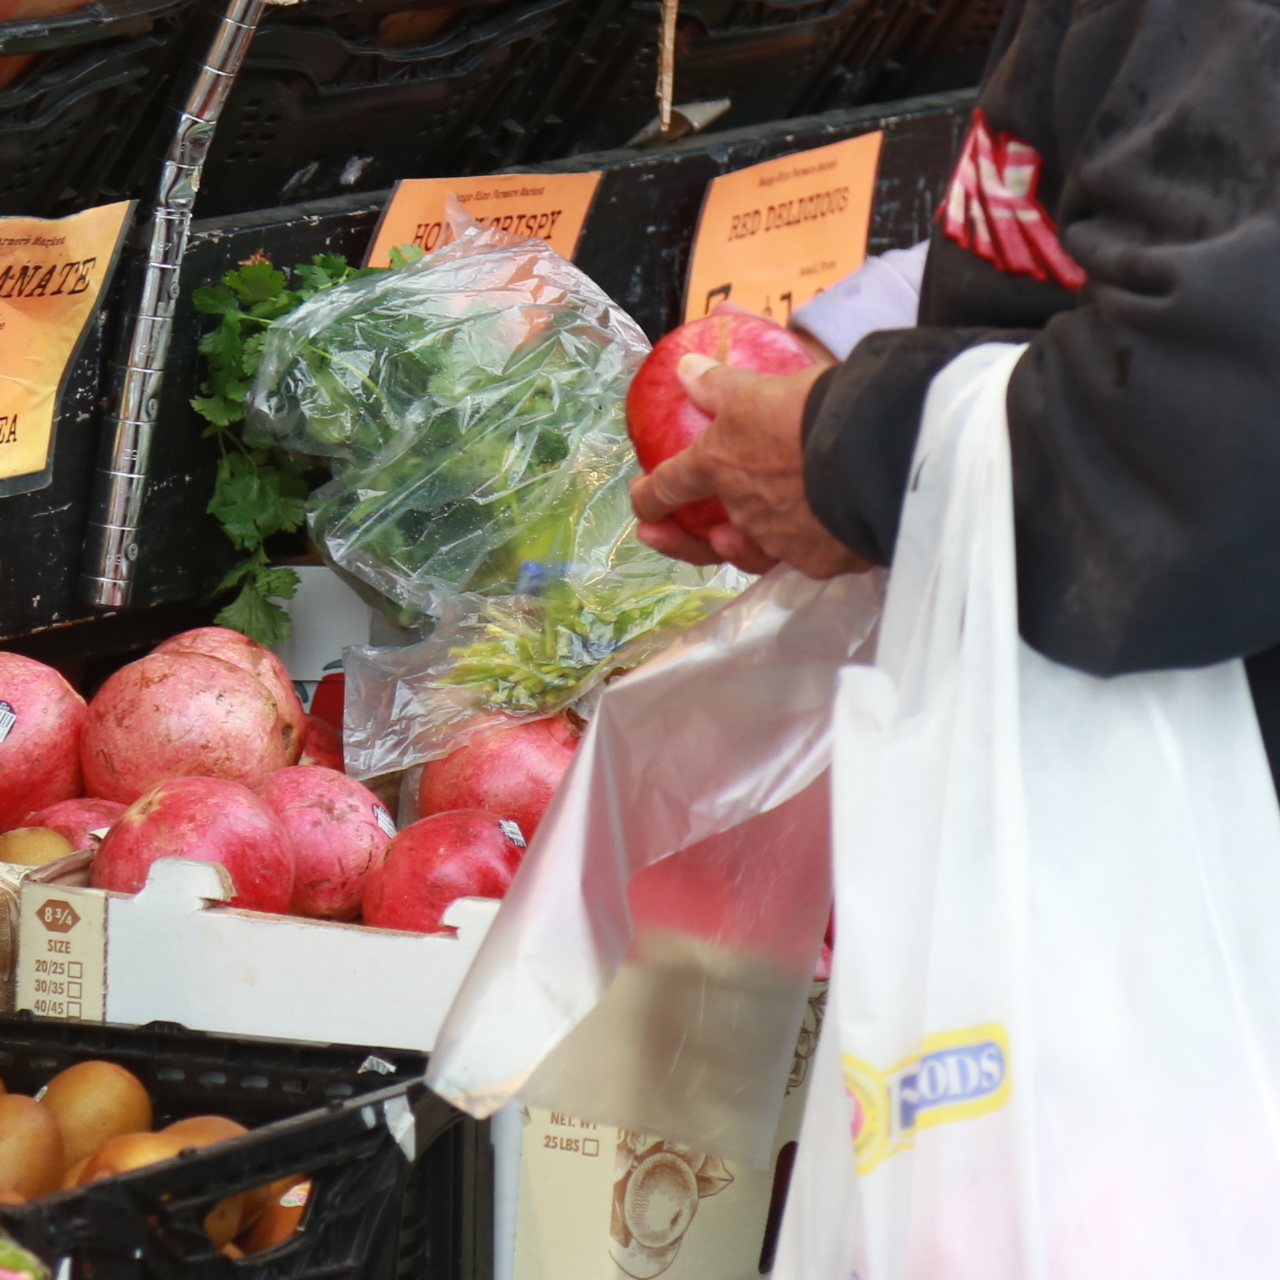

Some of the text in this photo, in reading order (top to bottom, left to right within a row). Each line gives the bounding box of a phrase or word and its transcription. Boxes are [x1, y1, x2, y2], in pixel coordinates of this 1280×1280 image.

[456, 193, 473, 204] ango
[728, 186, 850, 242] RED DELICIOUS
[32, 235, 66, 249] Market
[46, 939, 72, 955] SIZE
[35, 959, 65, 975] 20/25
[34, 979, 65, 996] 30/35
[33, 999, 65, 1015] 40/45
[543, 1134, 580, 1153] 25 LBS
